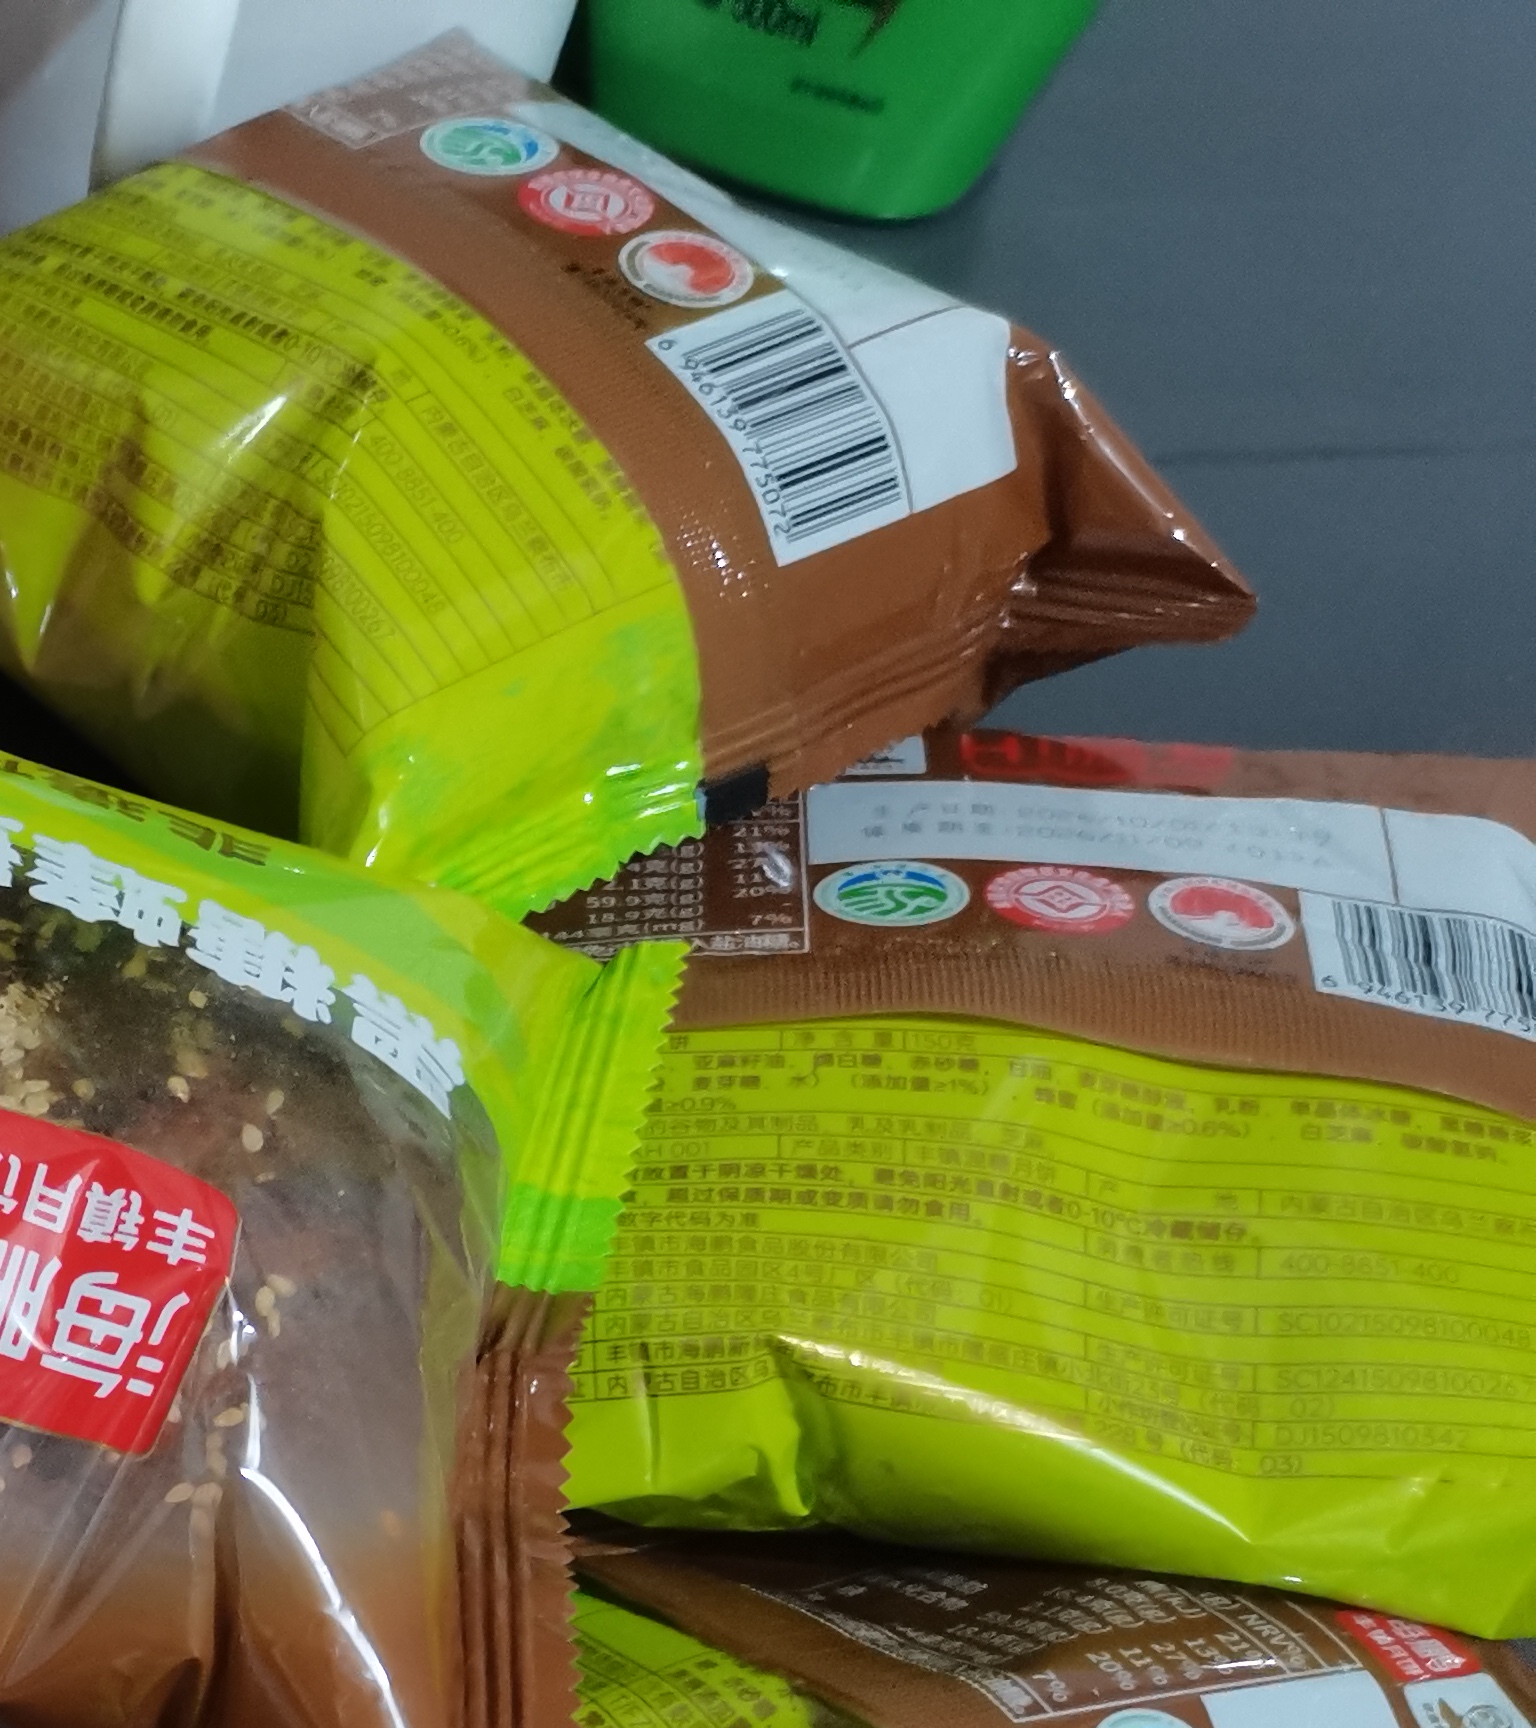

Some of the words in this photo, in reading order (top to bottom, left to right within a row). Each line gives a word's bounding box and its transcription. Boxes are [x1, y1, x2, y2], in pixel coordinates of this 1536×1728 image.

[657, 338, 676, 352] 6
[681, 354, 748, 432] 946139
[741, 438, 793, 535] 775072
[1237, 1612, 1309, 1672] NRV%
